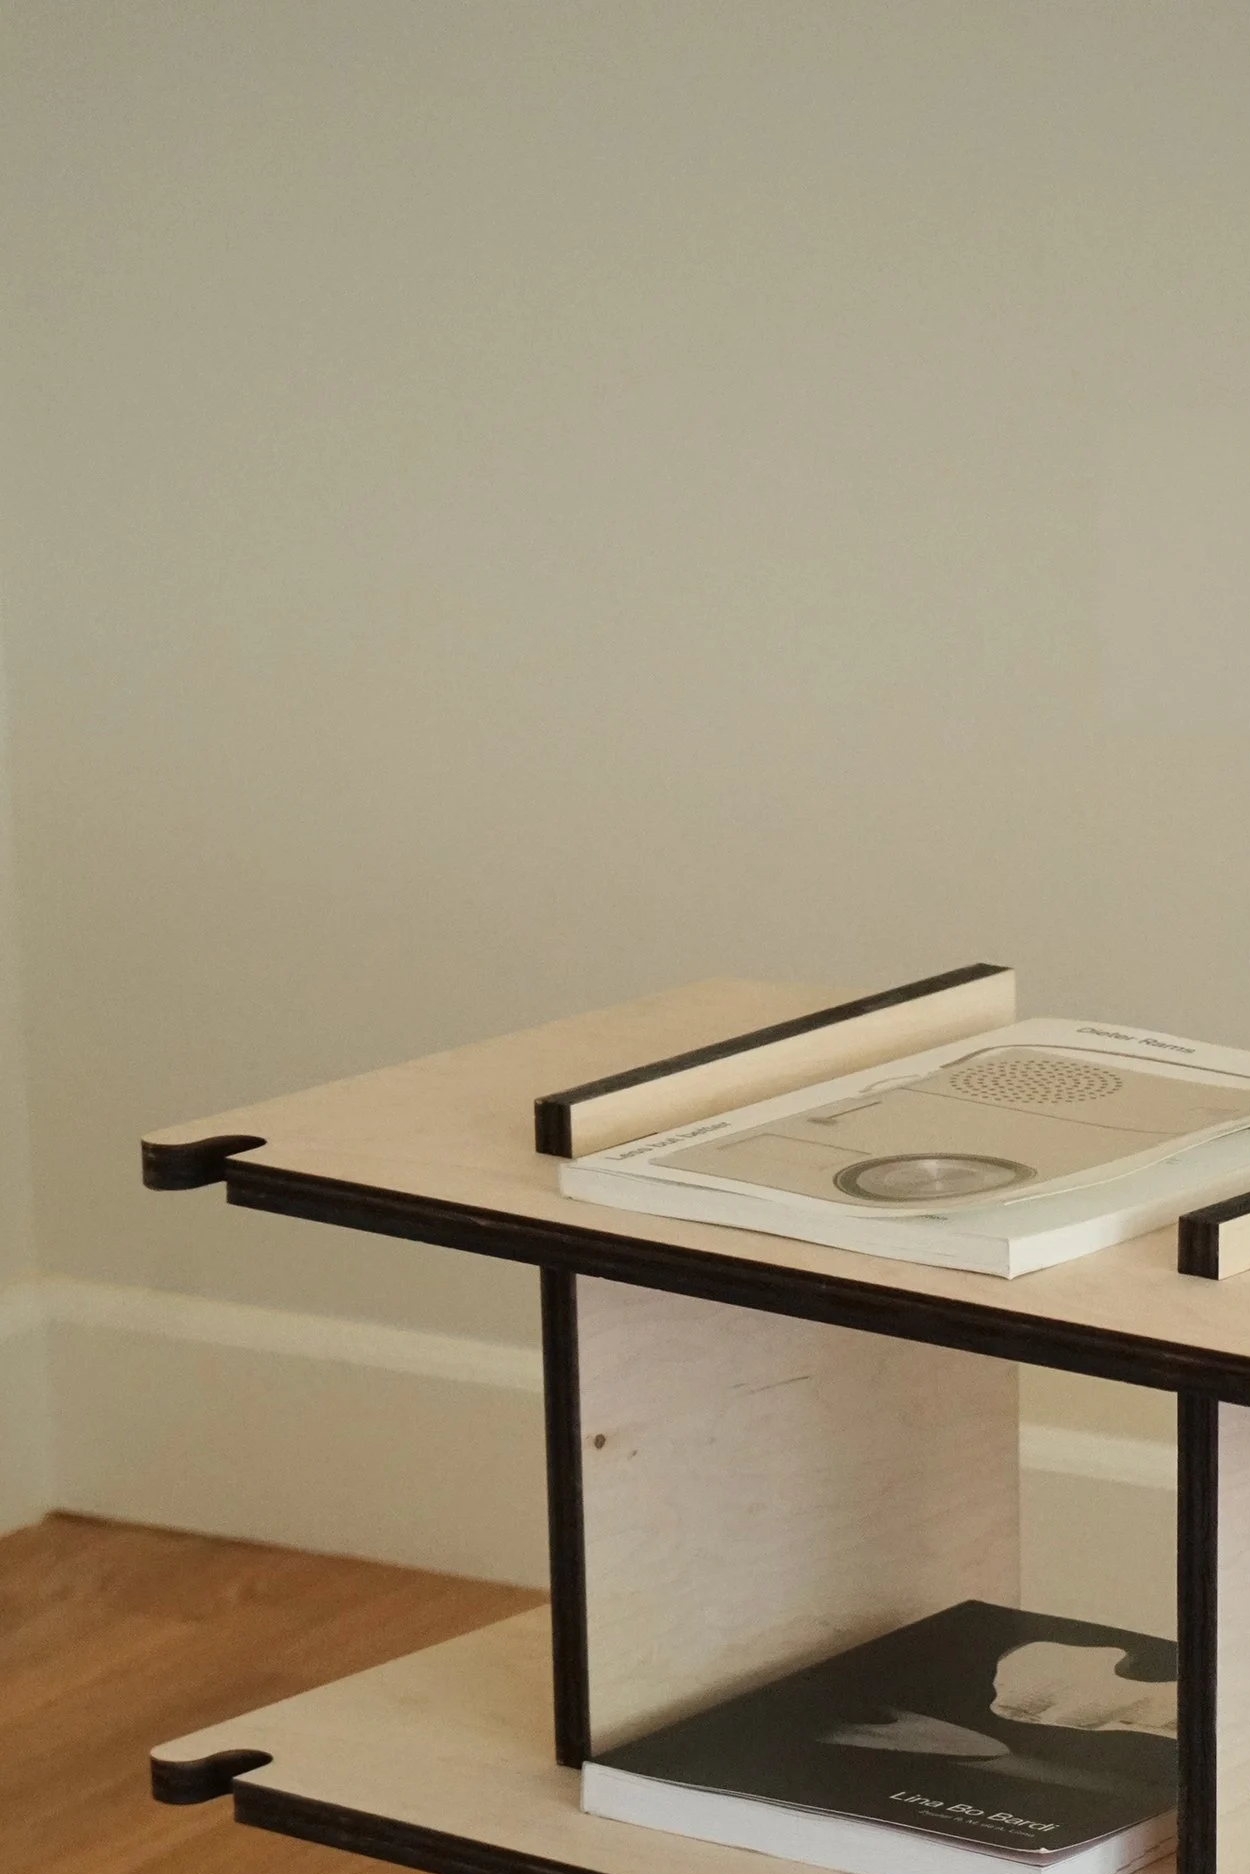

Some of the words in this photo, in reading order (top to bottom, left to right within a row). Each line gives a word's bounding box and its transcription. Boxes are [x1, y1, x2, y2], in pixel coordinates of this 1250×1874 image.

[1076, 1026, 1137, 1041] Dieter
[1137, 1037, 1197, 1054] Rams
[603, 1147, 653, 1161] Less
[644, 1137, 685, 1149] but
[675, 1120, 733, 1138] better
[888, 1791, 945, 1809] Lina
[946, 1802, 985, 1817] Bo
[986, 1811, 1061, 1833] Bardi
